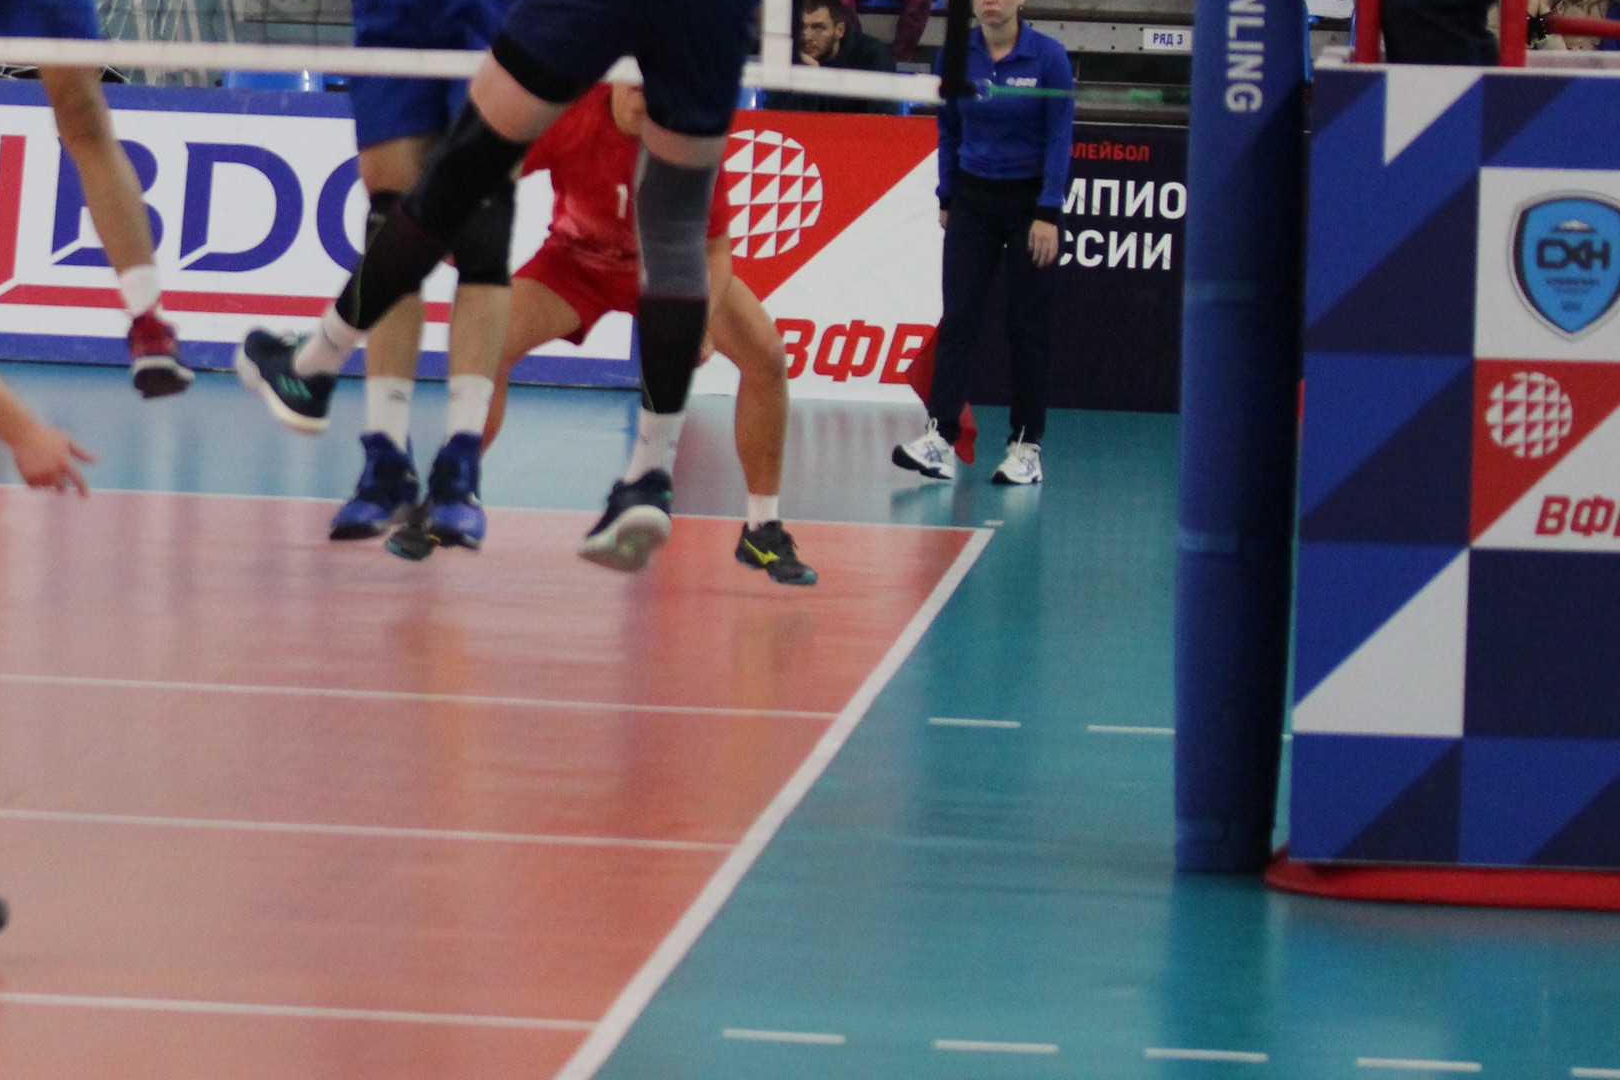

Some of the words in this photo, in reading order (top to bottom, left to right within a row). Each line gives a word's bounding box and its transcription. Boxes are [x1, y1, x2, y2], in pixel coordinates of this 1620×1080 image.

[1152, 33, 1174, 47] РЯД
[1176, 33, 1183, 45] 3
[1535, 494, 1620, 538] ВФ
